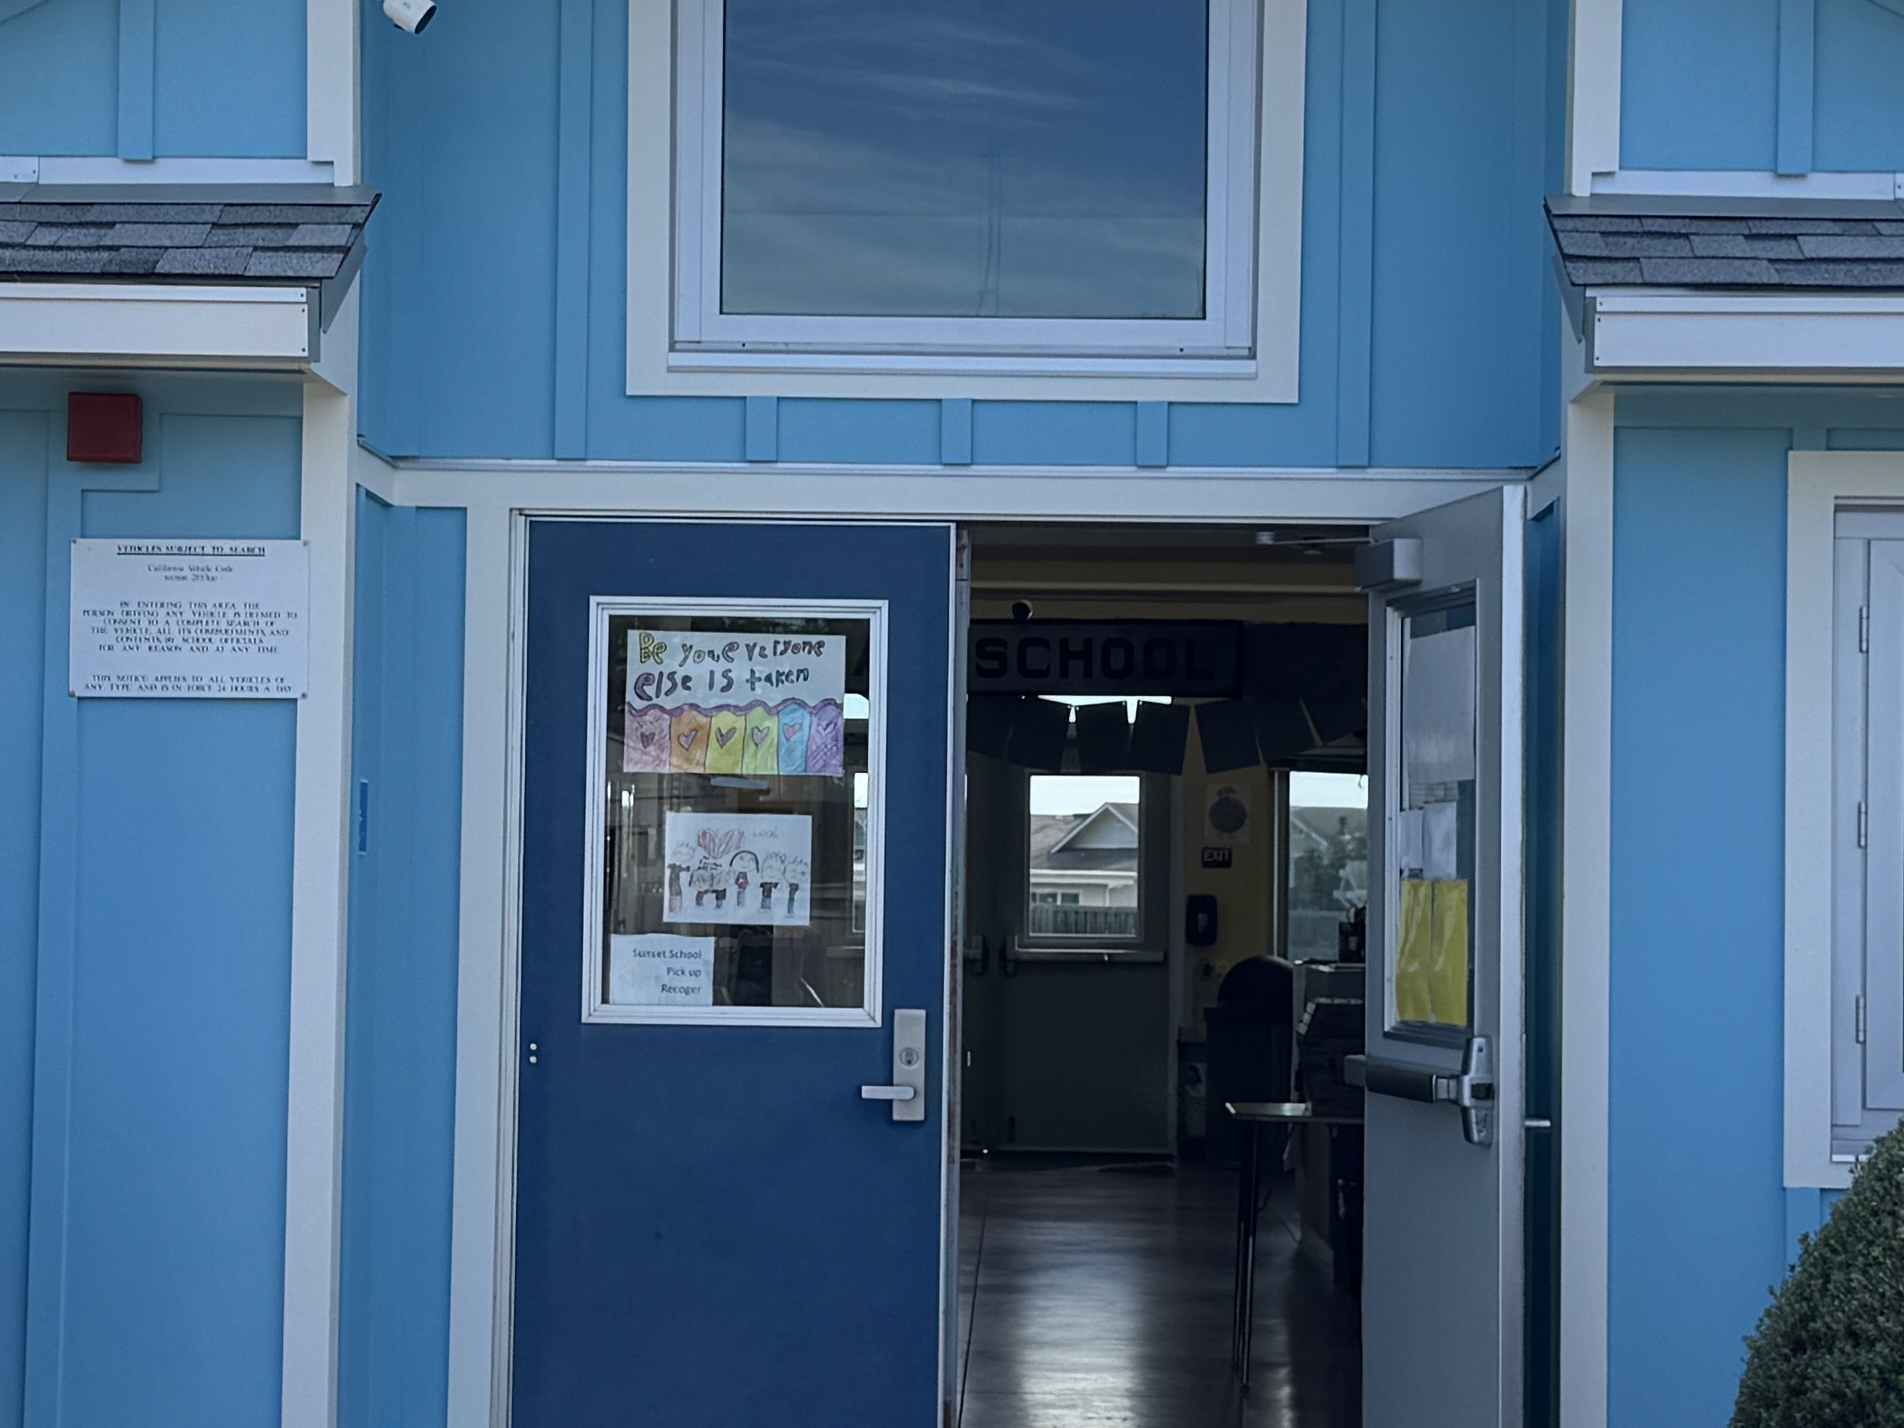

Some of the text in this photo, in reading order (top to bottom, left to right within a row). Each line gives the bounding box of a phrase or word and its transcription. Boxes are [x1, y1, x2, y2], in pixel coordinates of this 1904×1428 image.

[638, 632, 668, 665] Be
[975, 636, 1216, 680] SCHOOL
[633, 670, 693, 702] else
[746, 667, 810, 692] taken
[1203, 849, 1231, 862] EXIT
[669, 948, 702, 959] School
[667, 966, 702, 978] Pick up
[660, 983, 702, 996] Recoger
